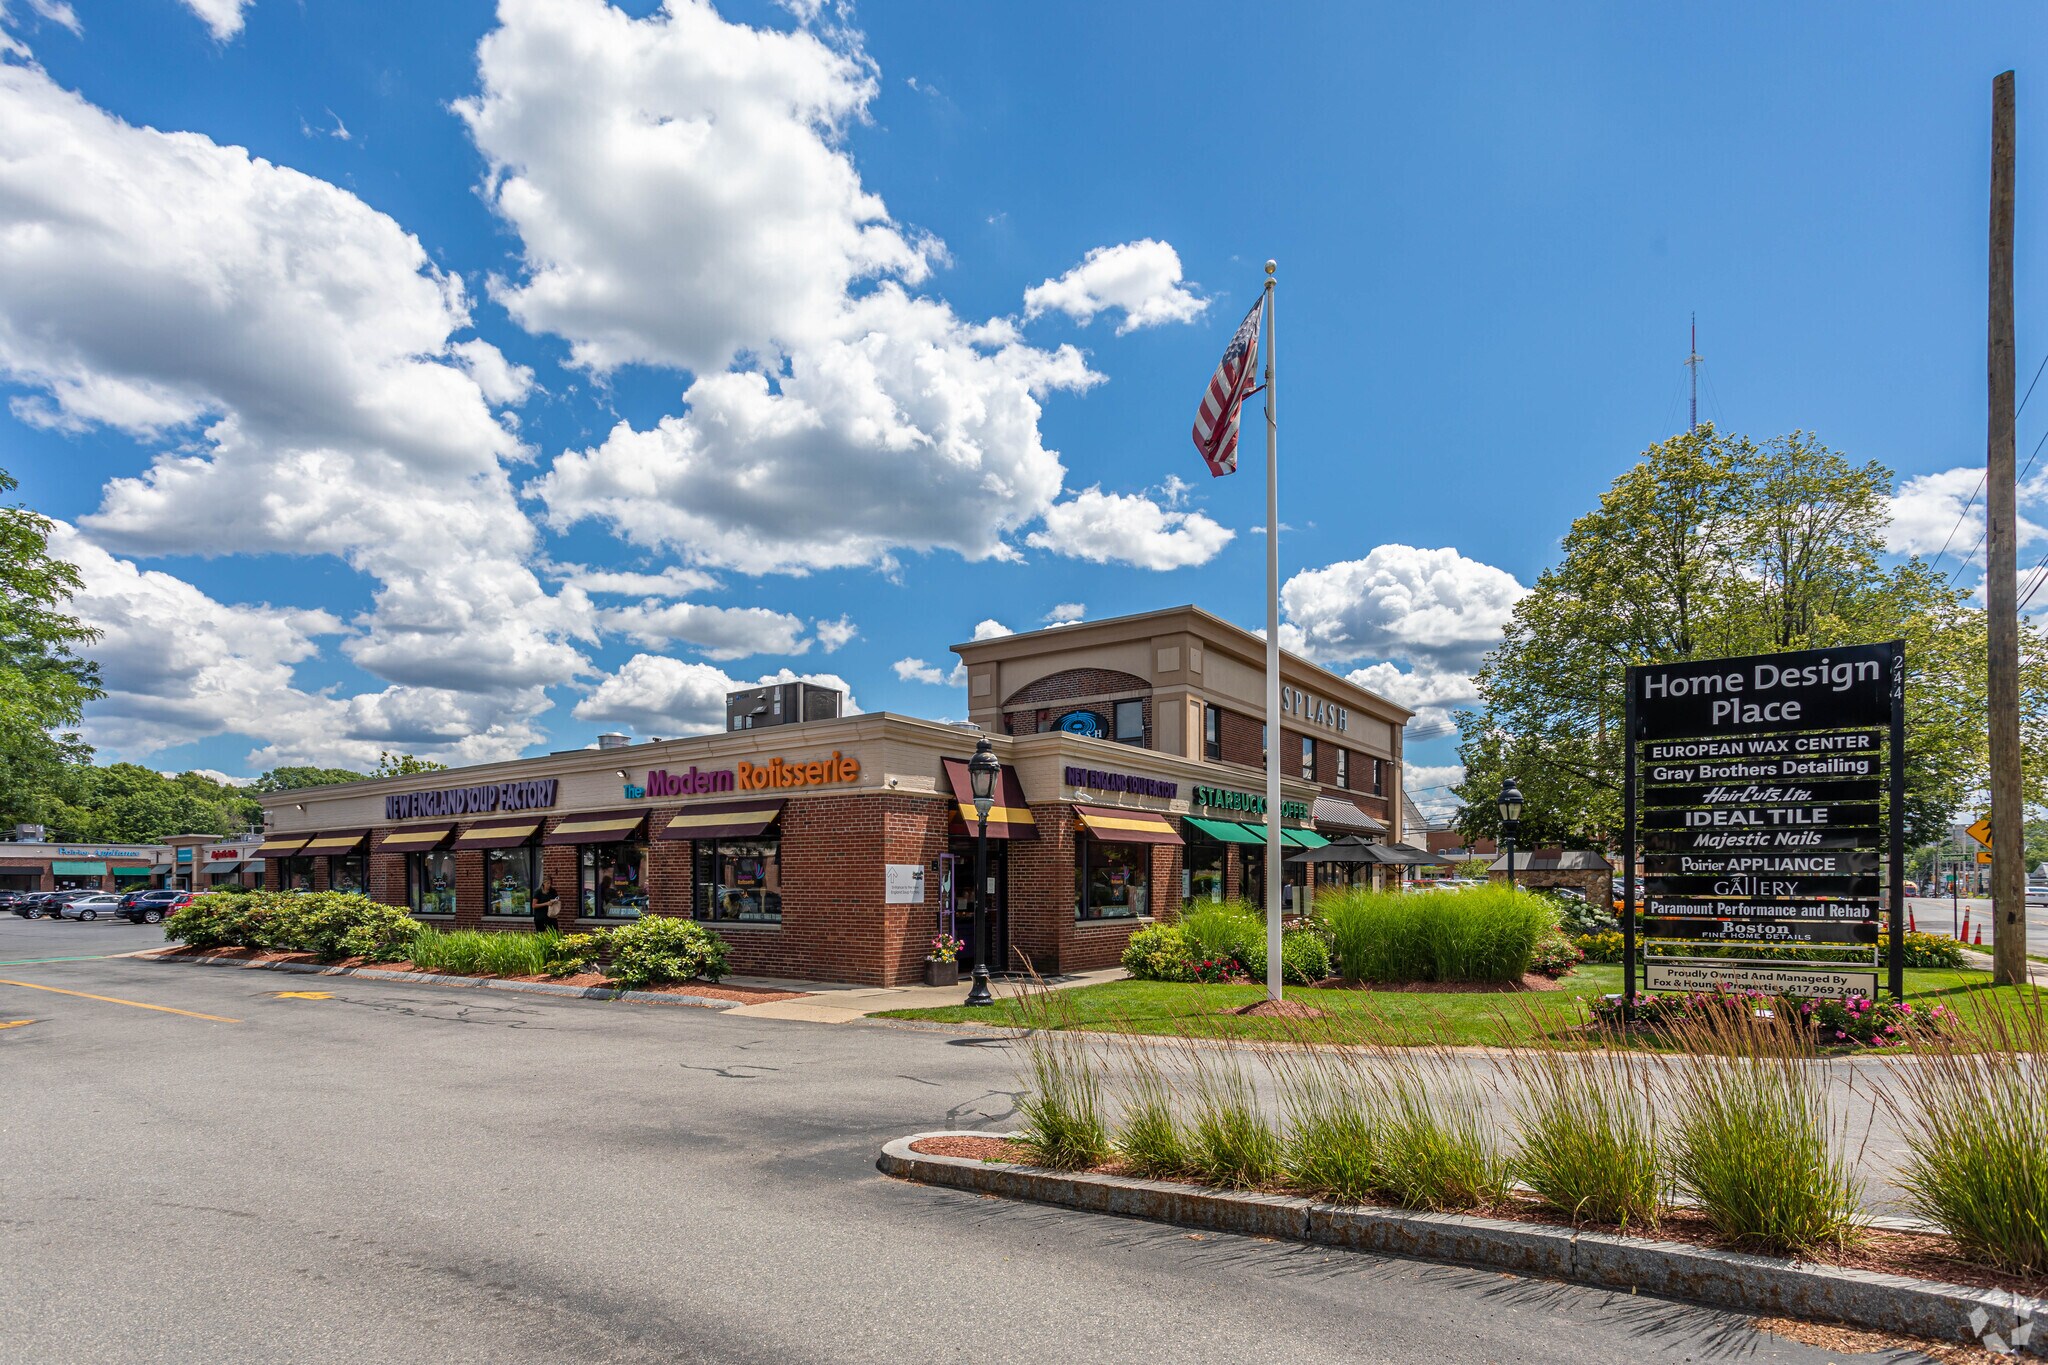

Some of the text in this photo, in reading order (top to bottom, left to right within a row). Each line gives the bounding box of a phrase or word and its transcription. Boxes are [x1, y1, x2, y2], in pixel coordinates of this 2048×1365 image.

[1645, 658, 1879, 699] Home Design
[1893, 655, 1904, 699] 244
[1282, 686, 1347, 731] SPLASH
[1712, 698, 1801, 725] Place
[1652, 735, 1870, 758] EUROPEAN WAX CENTER
[623, 751, 860, 799] The Modern Rotisserie
[1653, 759, 1869, 782] Gray Brothers Detailing
[1065, 766, 1178, 799] NEW ENGLAND SOUP FACTORY
[385, 778, 559, 820] NEW ENGLAND SOUP FACTORY
[1280, 799, 1308, 819] OFFEE
[1685, 808, 1828, 826] IDEAL TILE
[1693, 831, 1822, 849] Majestic Nails
[1681, 856, 1836, 871] Poirier APPLIANCE
[1650, 901, 1870, 918] Paramount Performance and Rehab
[1722, 921, 1789, 934] Boston
[1765, 933, 1812, 941] DETAILS
[1653, 979, 1671, 987] Fox
[1673, 979, 1682, 987] &
[1684, 979, 1722, 989] Houn
[1788, 984, 1810, 993] 617
[1812, 985, 1835, 994] 969
[1837, 986, 1867, 996] 2400
[1667, 969, 1848, 985] Proudly Owned And Managed By
